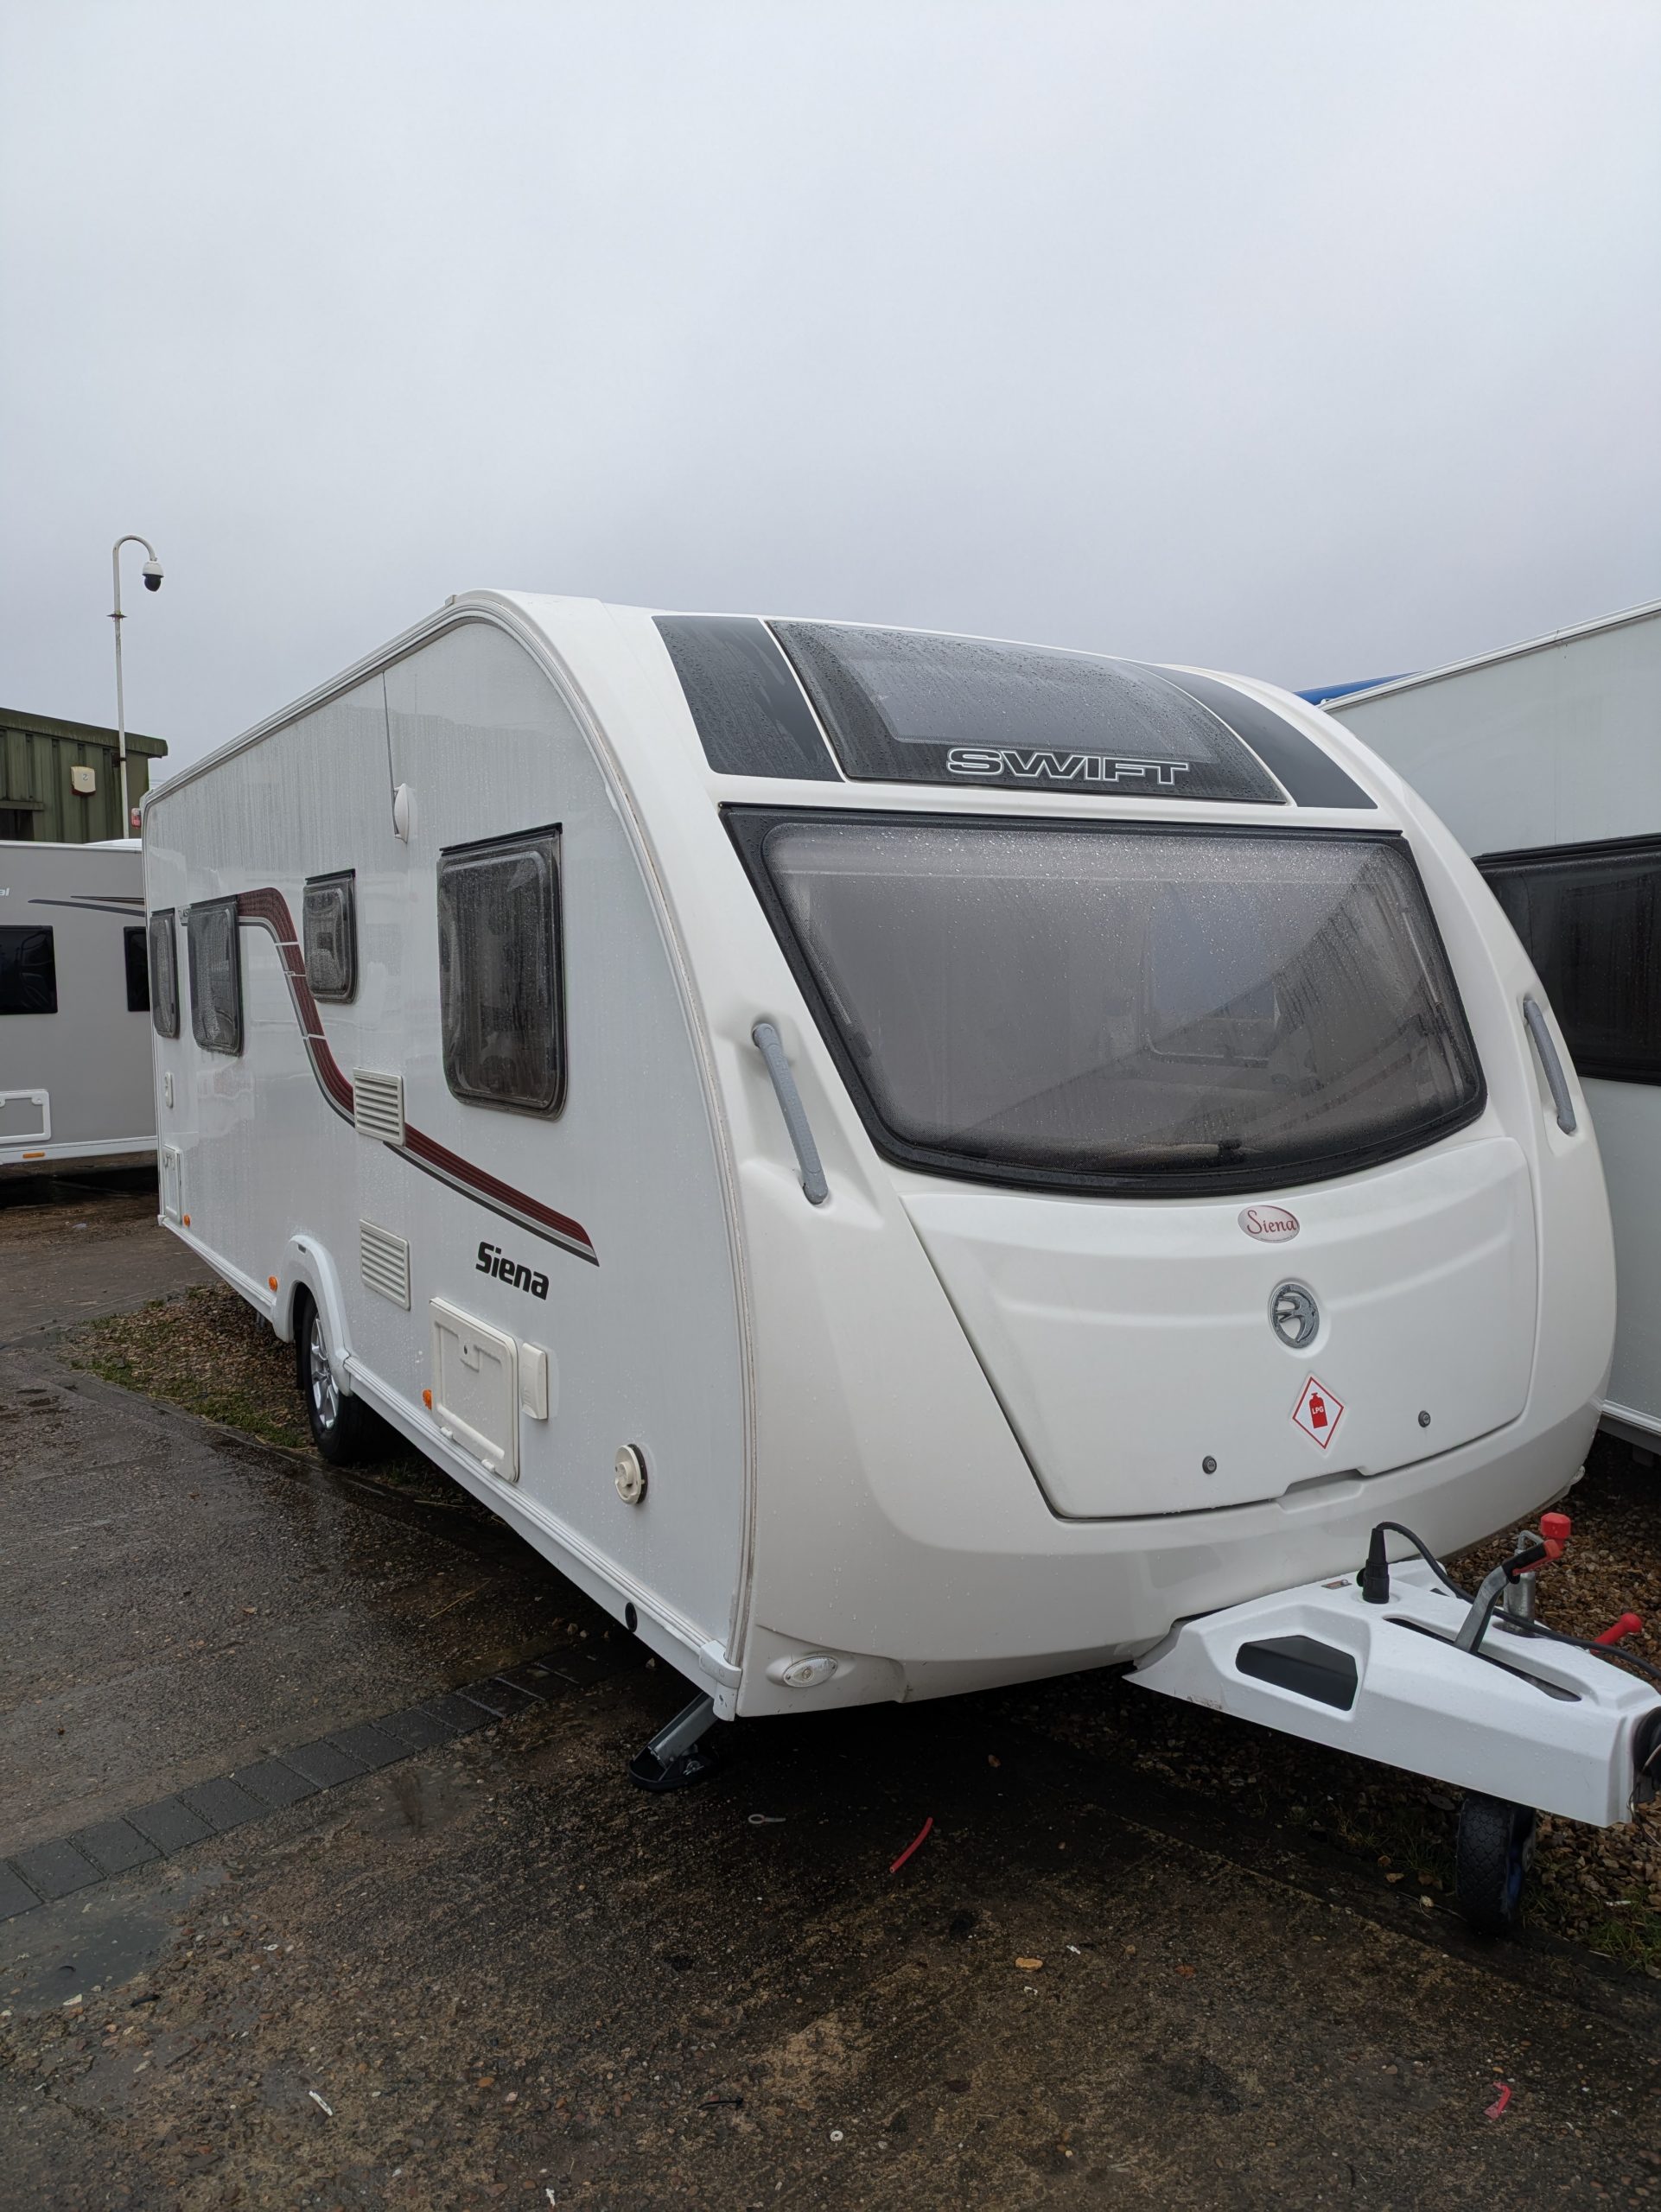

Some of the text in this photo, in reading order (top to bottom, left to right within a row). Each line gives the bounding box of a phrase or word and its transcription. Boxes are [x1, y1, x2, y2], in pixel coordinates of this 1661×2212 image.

[947, 747, 1189, 785] SWIFT
[1246, 1210, 1296, 1234] Siena
[475, 1241, 549, 1300] Siena
[1312, 1406, 1324, 1414] LPG
